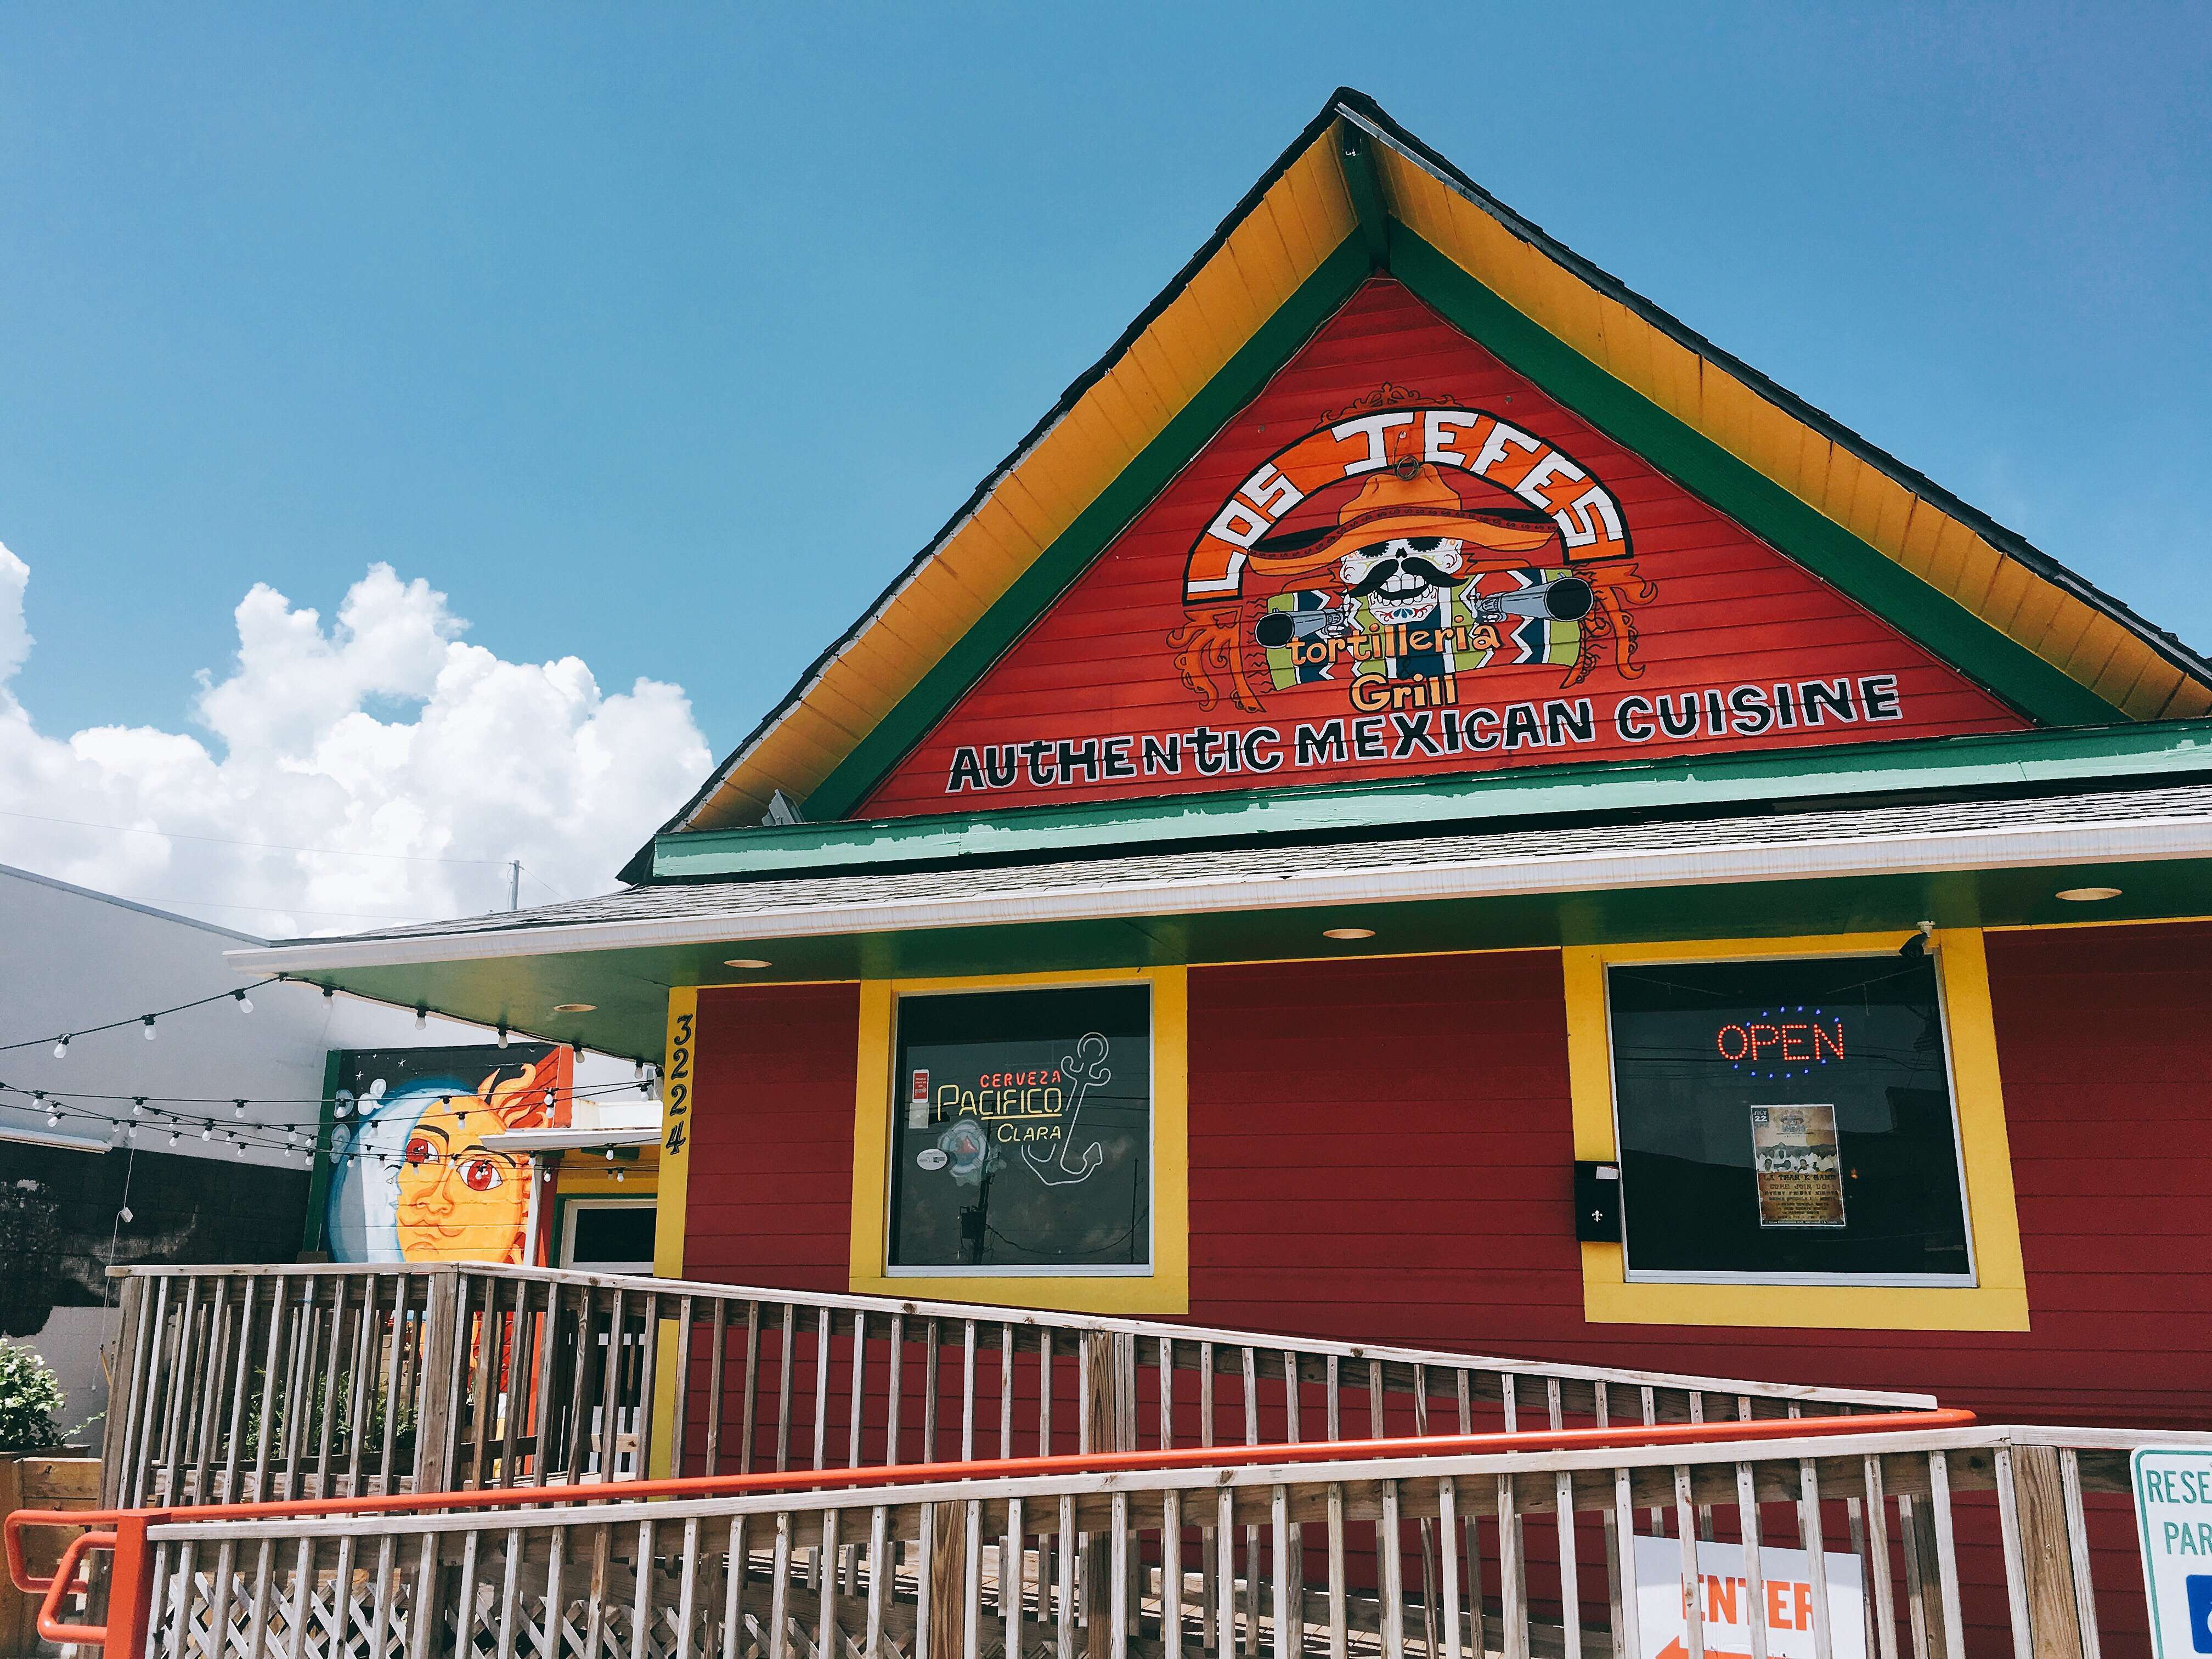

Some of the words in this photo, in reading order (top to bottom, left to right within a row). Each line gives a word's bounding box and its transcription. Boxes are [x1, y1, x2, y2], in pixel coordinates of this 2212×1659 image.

[1187, 462, 1305, 593] LOS
[1331, 410, 1624, 549] JEFES
[1285, 614, 1504, 666] tortilleria
[1350, 672, 1459, 712] Grill
[1295, 698, 1595, 768] MEXICAN
[1615, 674, 1903, 742] CUISINE
[1717, 1023, 1844, 1060] OPEN
[665, 1013, 693, 1155] 3224
[980, 1070, 1061, 1088] CERVEZA
[938, 1084, 1061, 1121] PACIFICO
[997, 1124, 1061, 1142] CLARA
